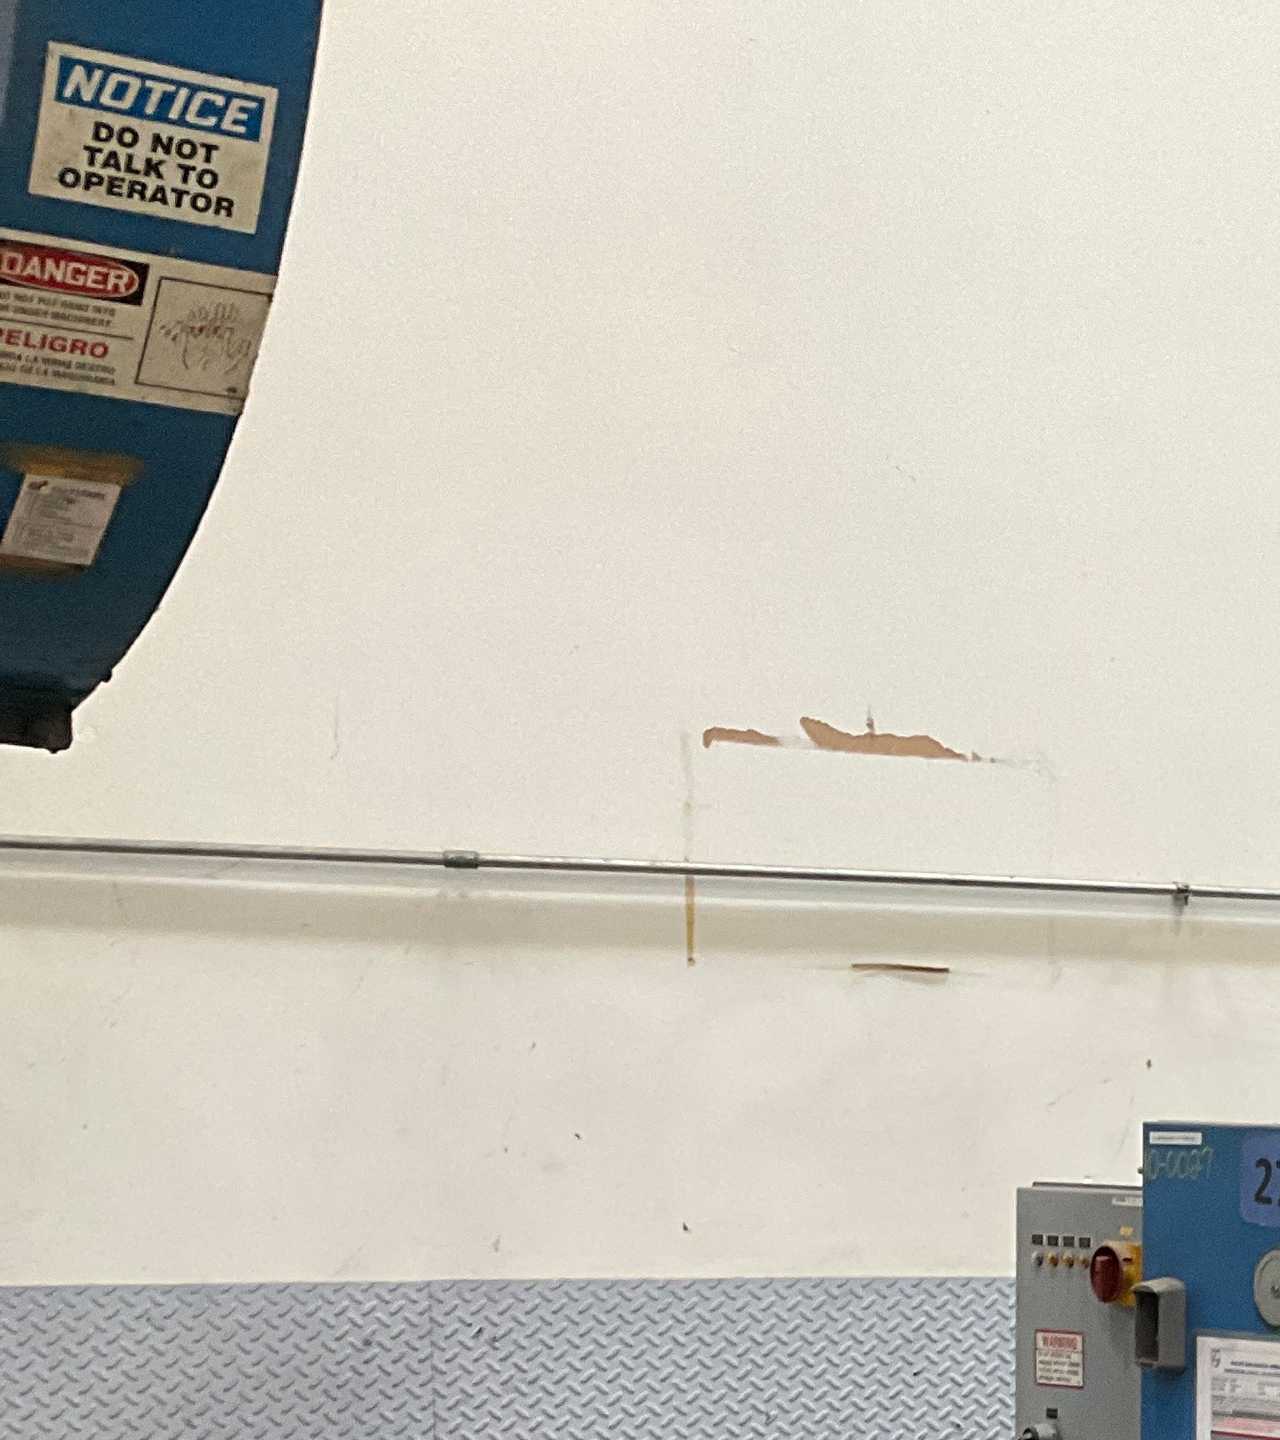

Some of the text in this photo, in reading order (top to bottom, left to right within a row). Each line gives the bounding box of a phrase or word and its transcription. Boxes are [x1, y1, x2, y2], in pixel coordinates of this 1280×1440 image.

[63, 64, 260, 134] NOTICE
[91, 121, 219, 164] DO NOT
[83, 145, 219, 190] TALK TO
[58, 166, 235, 219] OPERATOR
[0, 252, 130, 293] DANGER
[0, 328, 109, 359] ELIGRO
